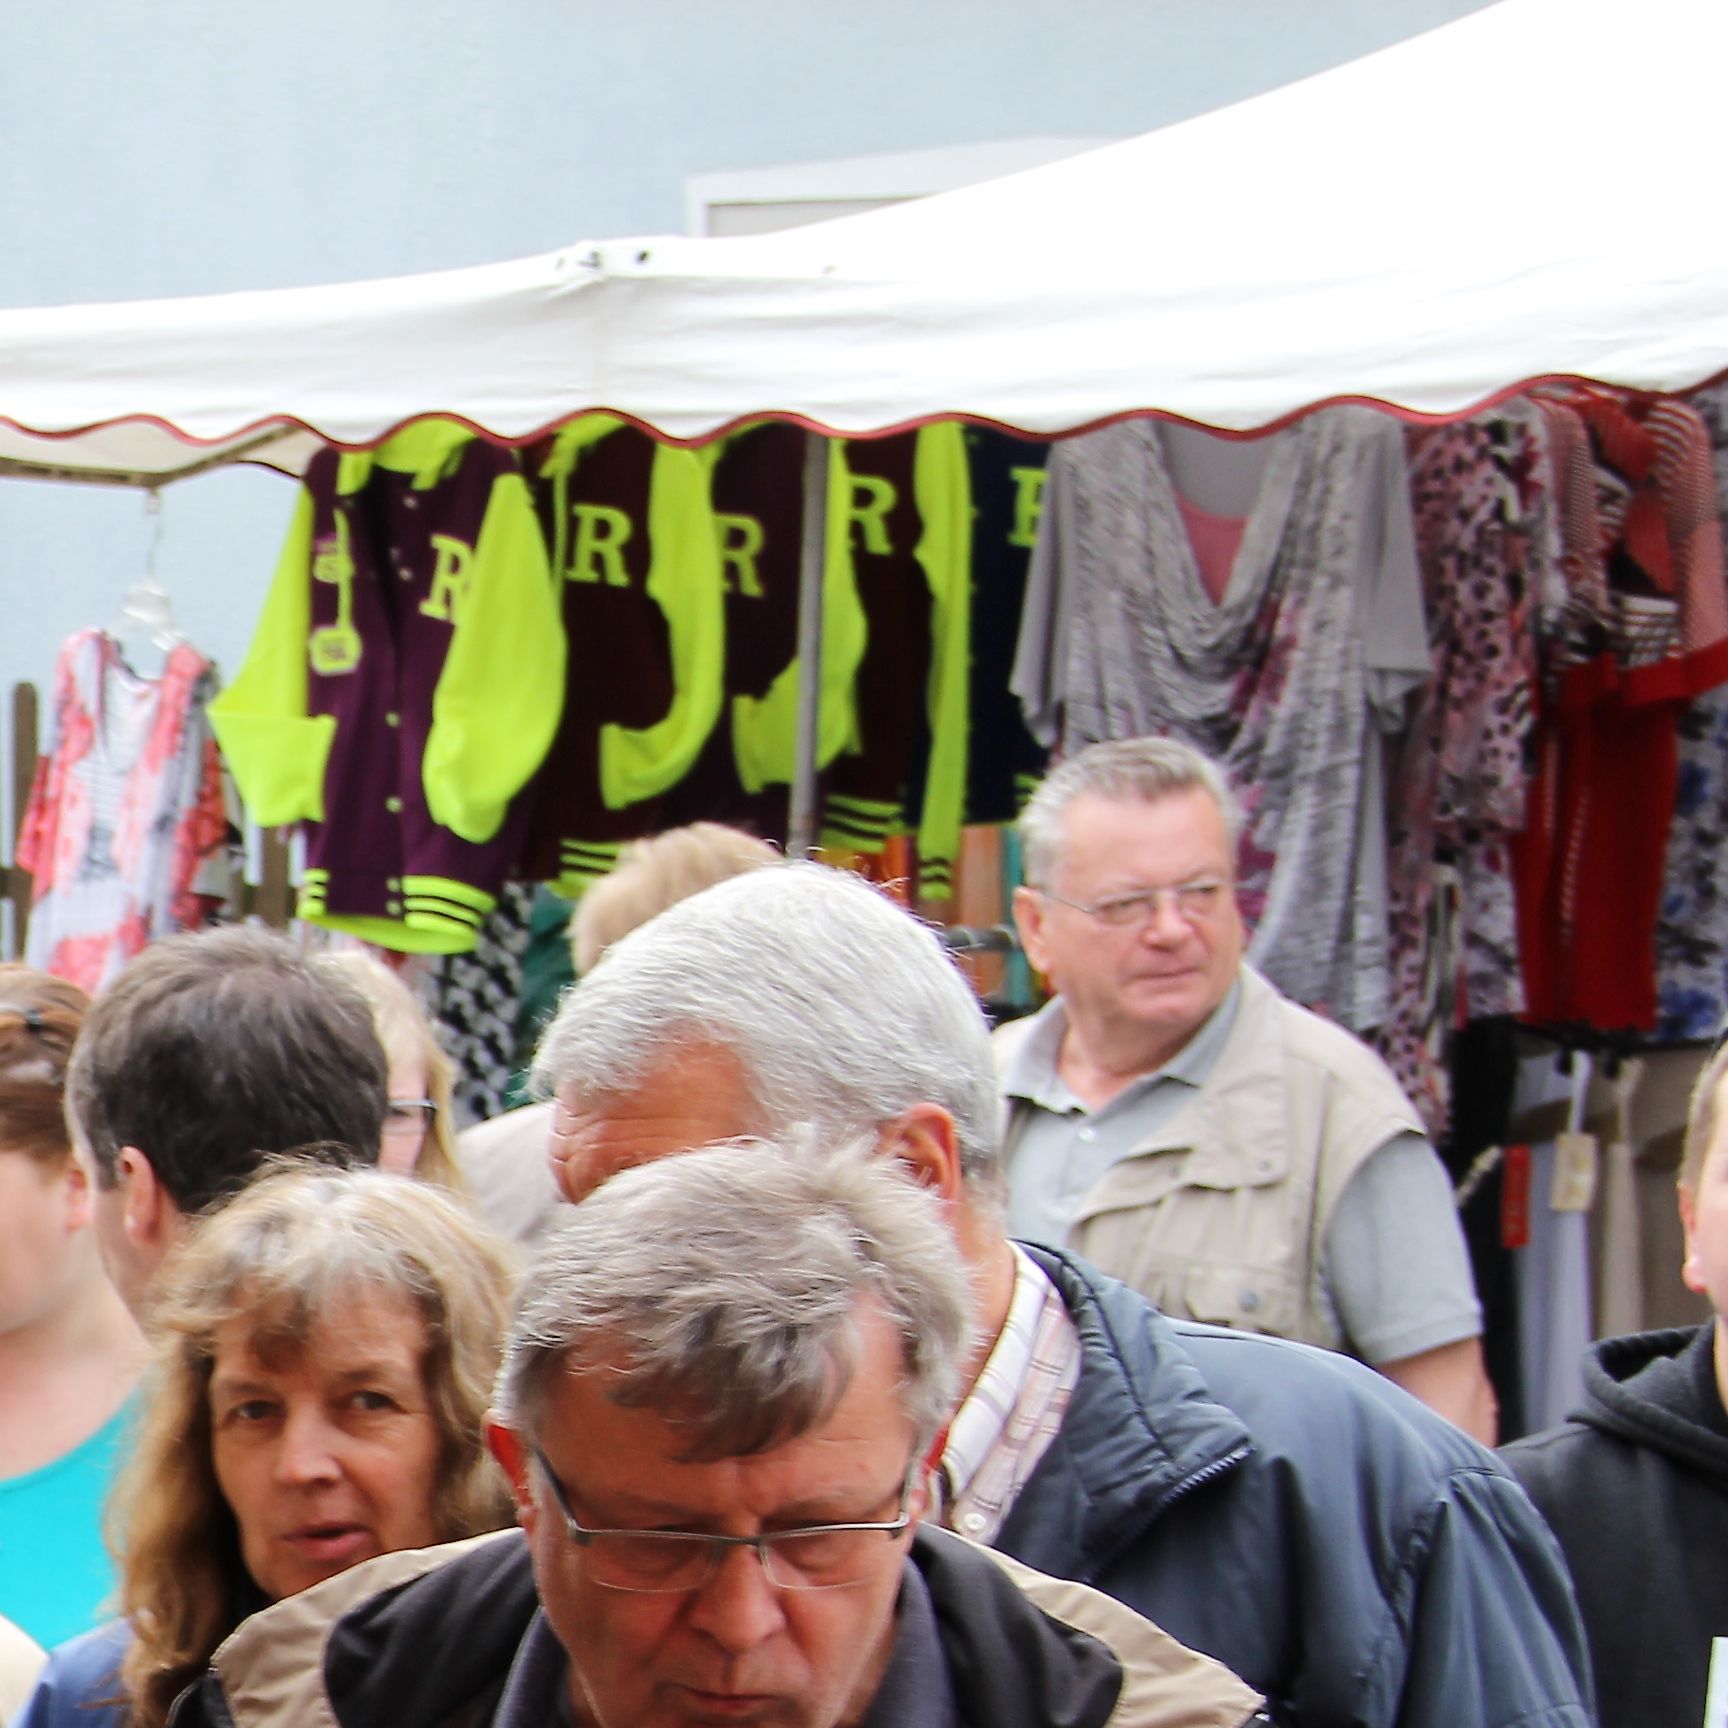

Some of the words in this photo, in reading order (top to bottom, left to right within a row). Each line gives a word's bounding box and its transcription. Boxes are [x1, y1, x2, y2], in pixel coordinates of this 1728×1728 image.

[566, 504, 632, 587] R
[713, 513, 764, 597] R
[846, 474, 896, 555] R
[419, 533, 477, 623] R
